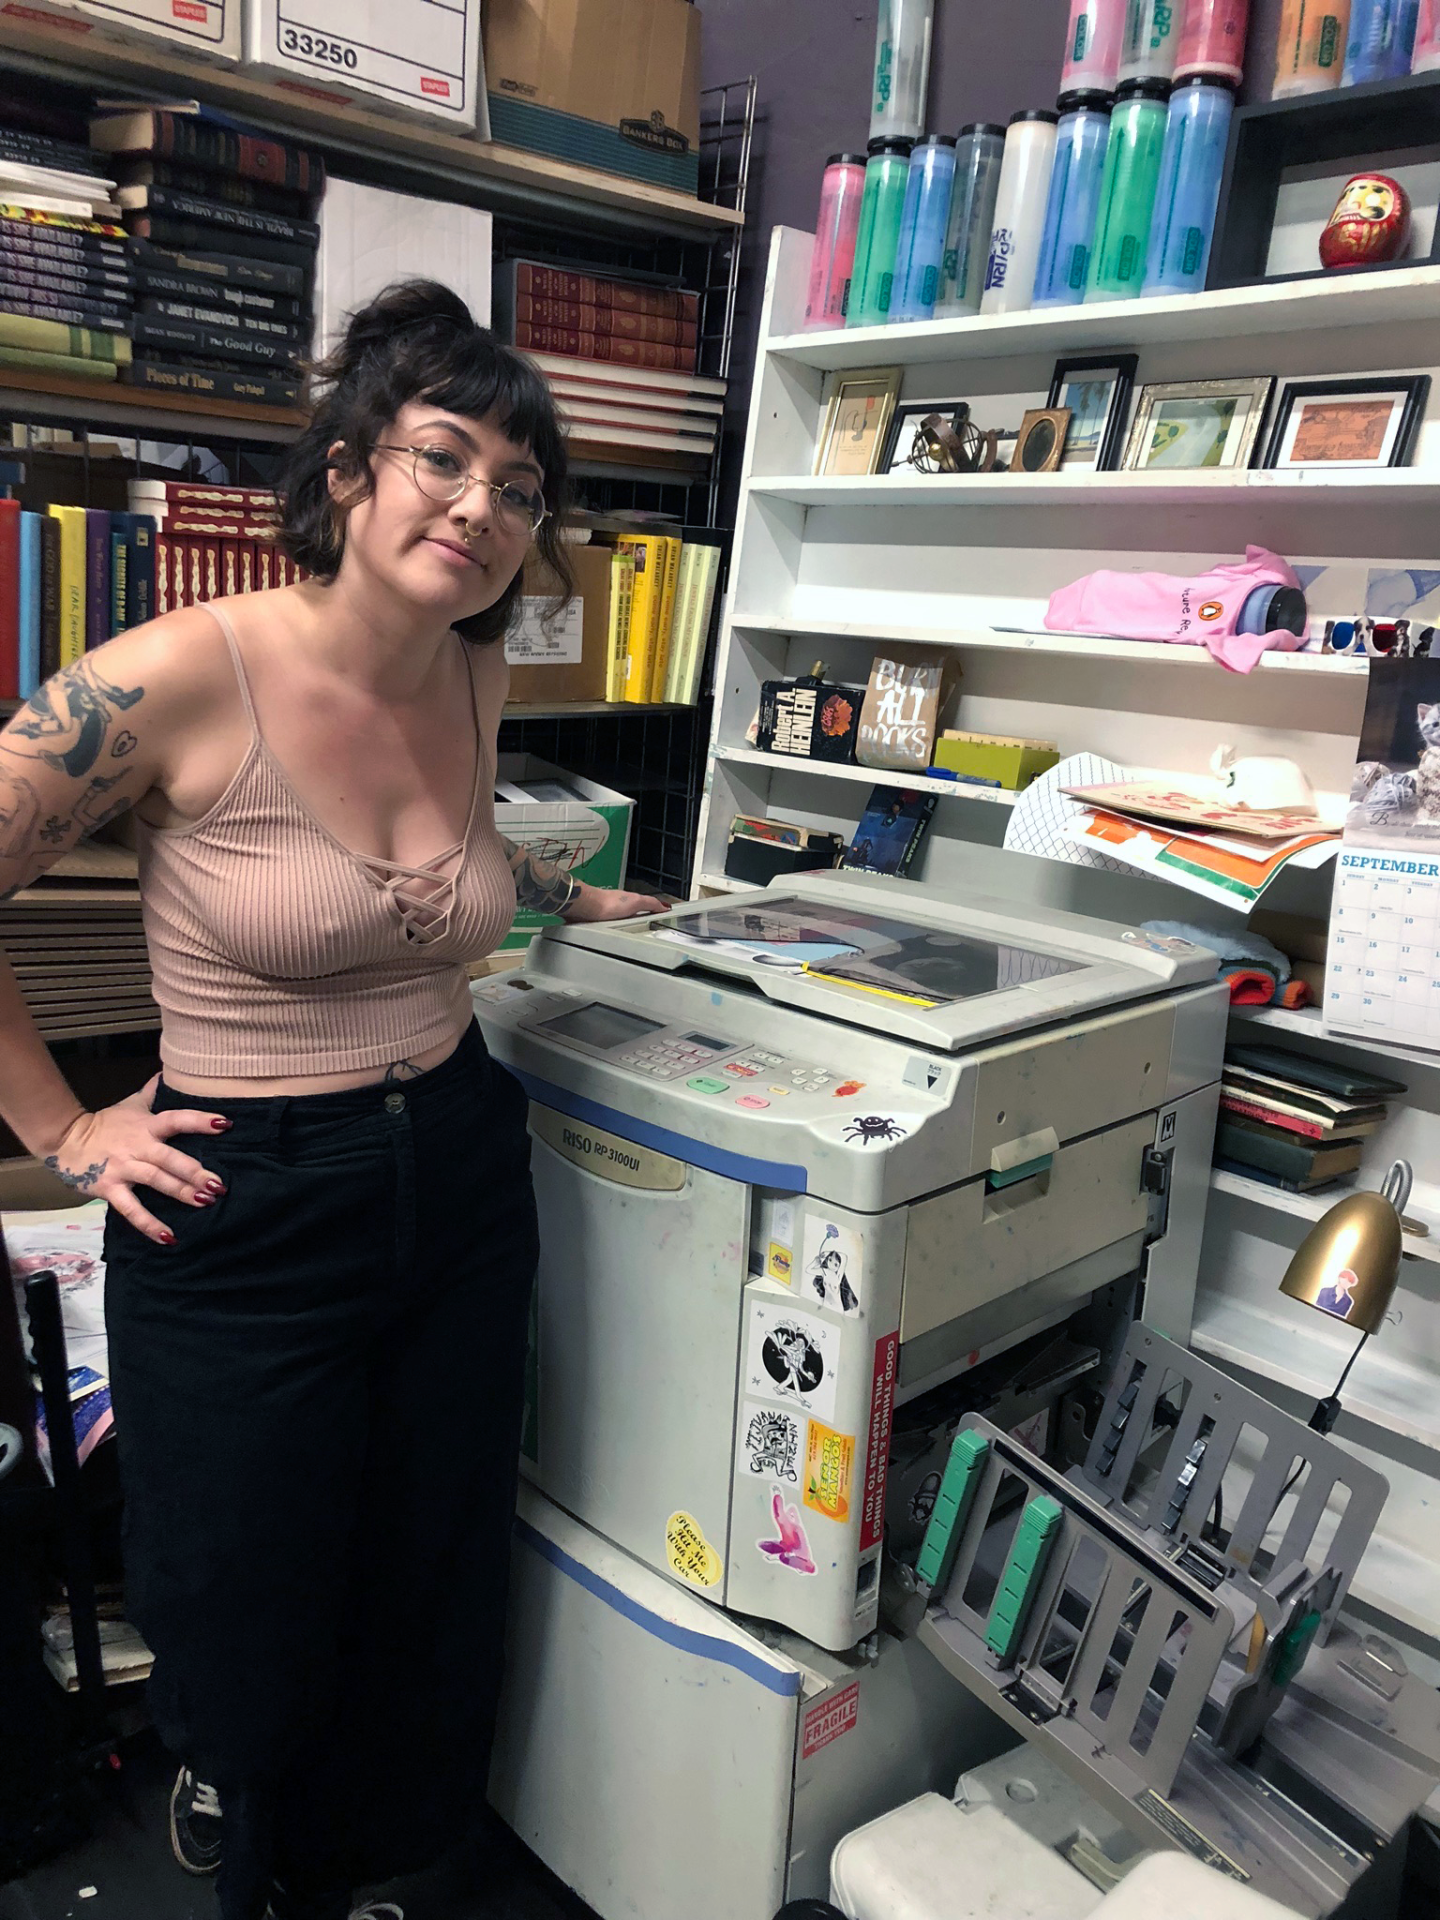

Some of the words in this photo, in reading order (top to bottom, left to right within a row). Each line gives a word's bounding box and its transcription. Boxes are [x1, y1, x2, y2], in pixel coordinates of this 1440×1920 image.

[284, 29, 357, 69] 33250
[622, 125, 664, 146] BANKERS
[666, 136, 683, 150] BOX
[224, 337, 253, 352] Good
[254, 342, 276, 358] Guy
[146, 366, 178, 386] Pieces
[190, 373, 215, 390] Time
[875, 657, 945, 698] BURN
[790, 688, 817, 756] HEINLEIN
[876, 689, 926, 727] ALL
[772, 704, 793, 752] Robert
[1342, 854, 1440, 877] SEPTEMBER
[1371, 912, 1376, 920] 9
[1336, 936, 1345, 944] 15
[929, 1064, 942, 1072] BLACK
[562, 1128, 592, 1154] RISO
[594, 1142, 608, 1156] RP
[608, 1148, 640, 1172] 3100UI
[885, 1340, 895, 1382] GOOD
[874, 1372, 884, 1410] WILL
[880, 1382, 892, 1438] THINGS
[870, 1412, 880, 1468] HAPPEN
[880, 1441, 888, 1451] &
[868, 1470, 876, 1490] TO
[876, 1454, 886, 1484] BAD
[865, 1492, 874, 1523] YOU
[872, 1484, 883, 1539] THINGS
[675, 1528, 692, 1548] Hit
[690, 1551, 706, 1568] Me
[676, 1516, 706, 1552] Please
[667, 1530, 686, 1558] With
[687, 1556, 710, 1586] Your
[674, 1558, 690, 1578] Car
[806, 1700, 856, 1744] FRAGILE
